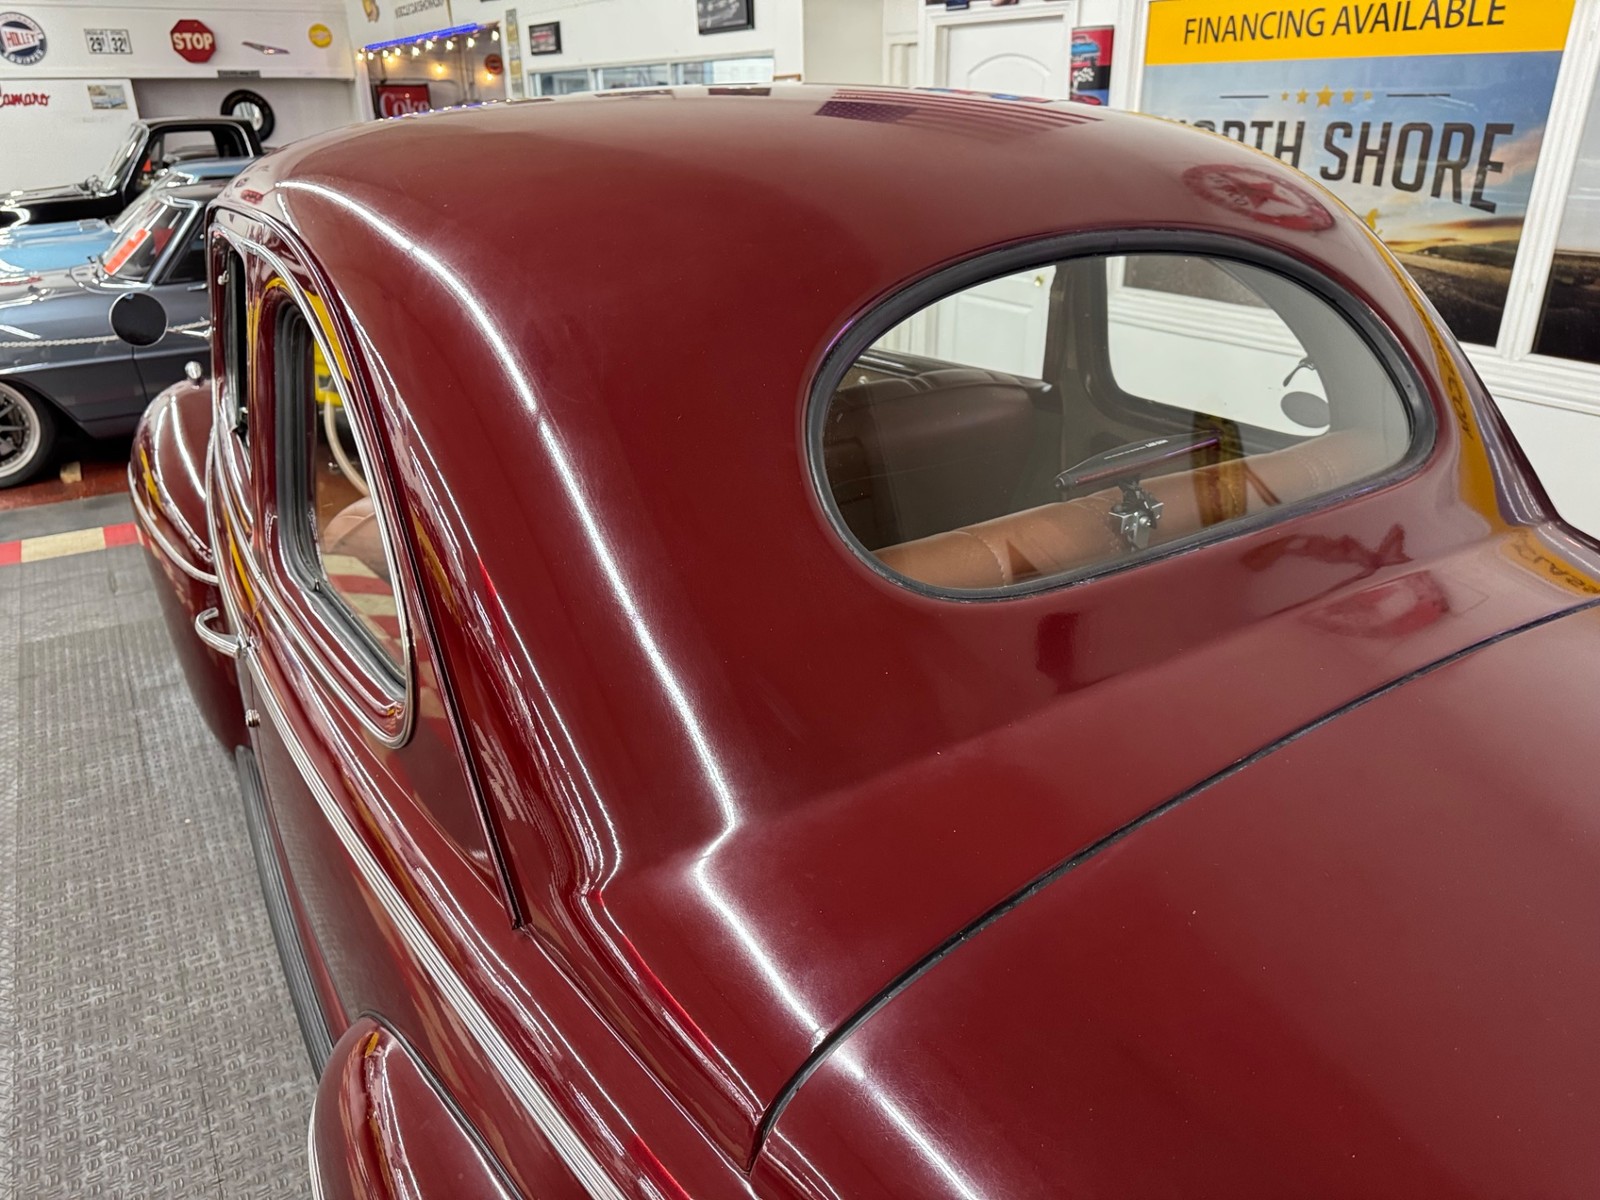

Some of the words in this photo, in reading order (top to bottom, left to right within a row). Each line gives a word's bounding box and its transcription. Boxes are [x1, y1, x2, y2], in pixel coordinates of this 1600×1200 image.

[1184, 7, 1326, 45] FINANCING
[1331, 0, 1507, 36] AVAILABLE
[4, 30, 36, 48] HOLLEY
[172, 32, 214, 50] STOP
[1319, 121, 1515, 214] SHORE
